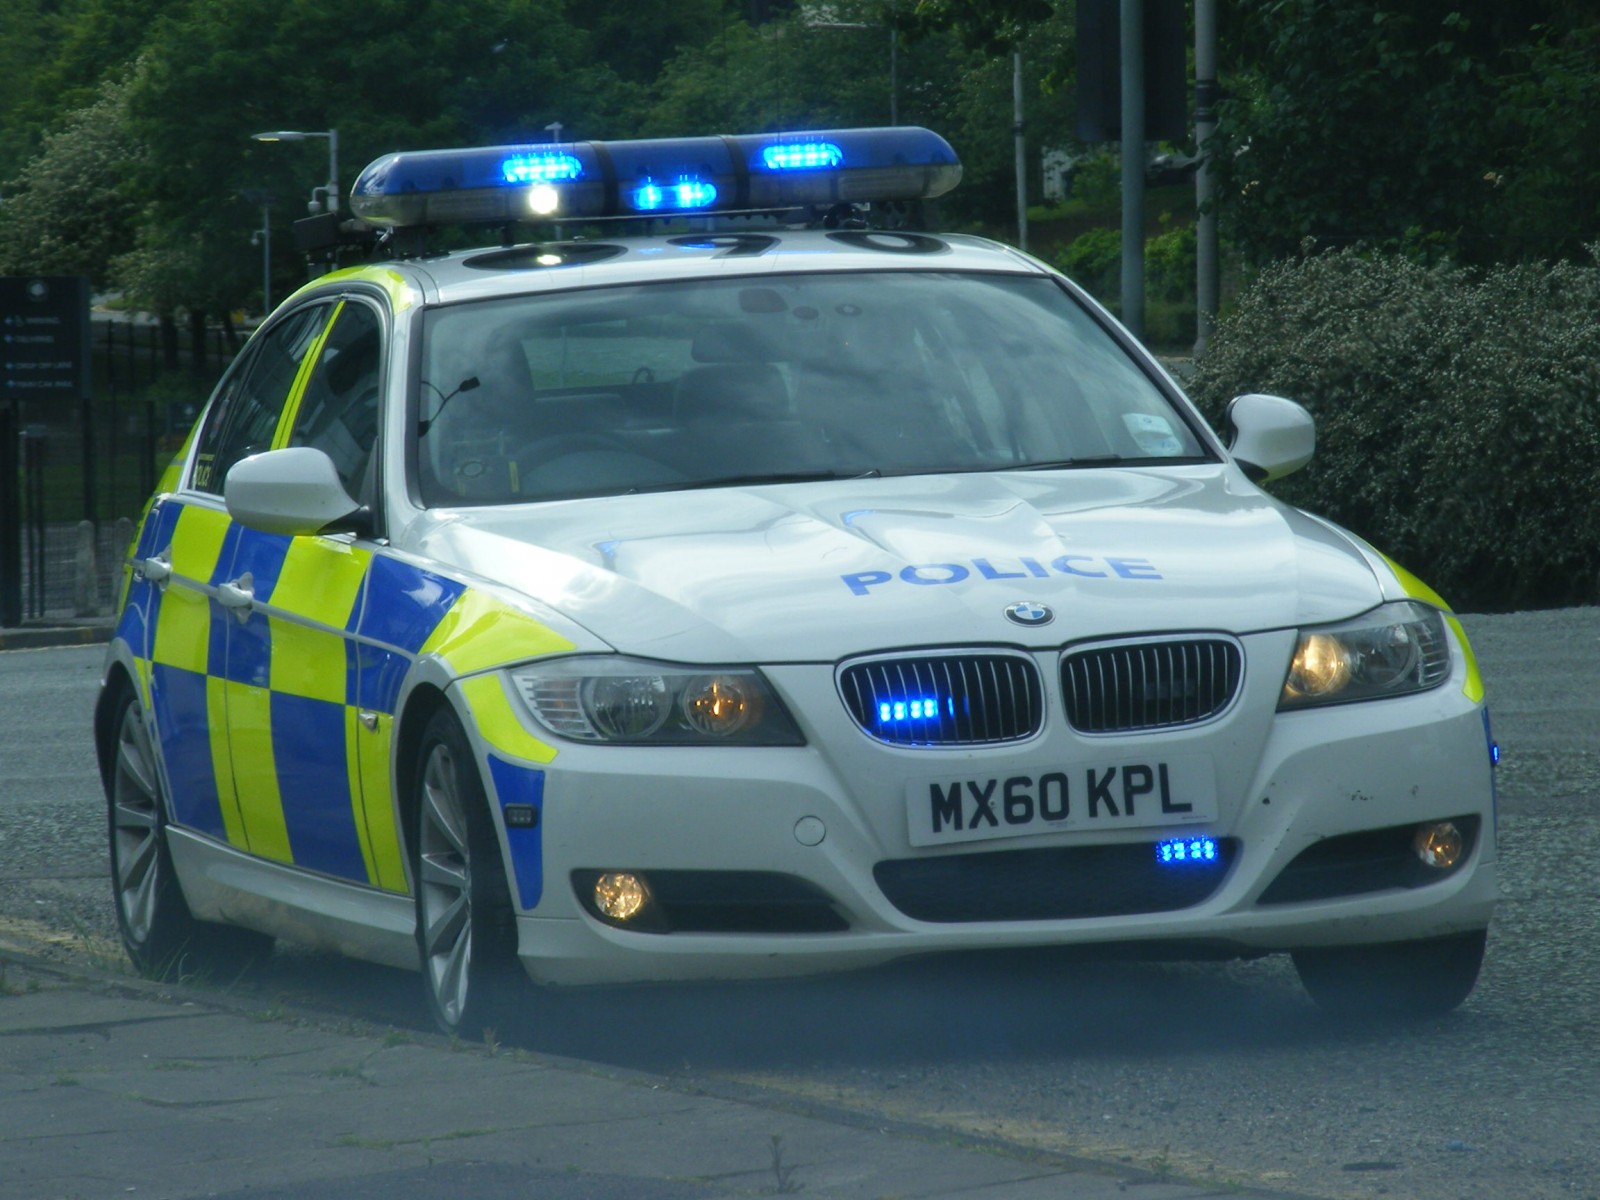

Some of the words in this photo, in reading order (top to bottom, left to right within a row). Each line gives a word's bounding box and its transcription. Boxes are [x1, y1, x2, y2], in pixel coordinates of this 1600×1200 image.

[839, 554, 1164, 597] POLICE
[929, 771, 1070, 834] MX60
[1086, 762, 1193, 819] KPL
